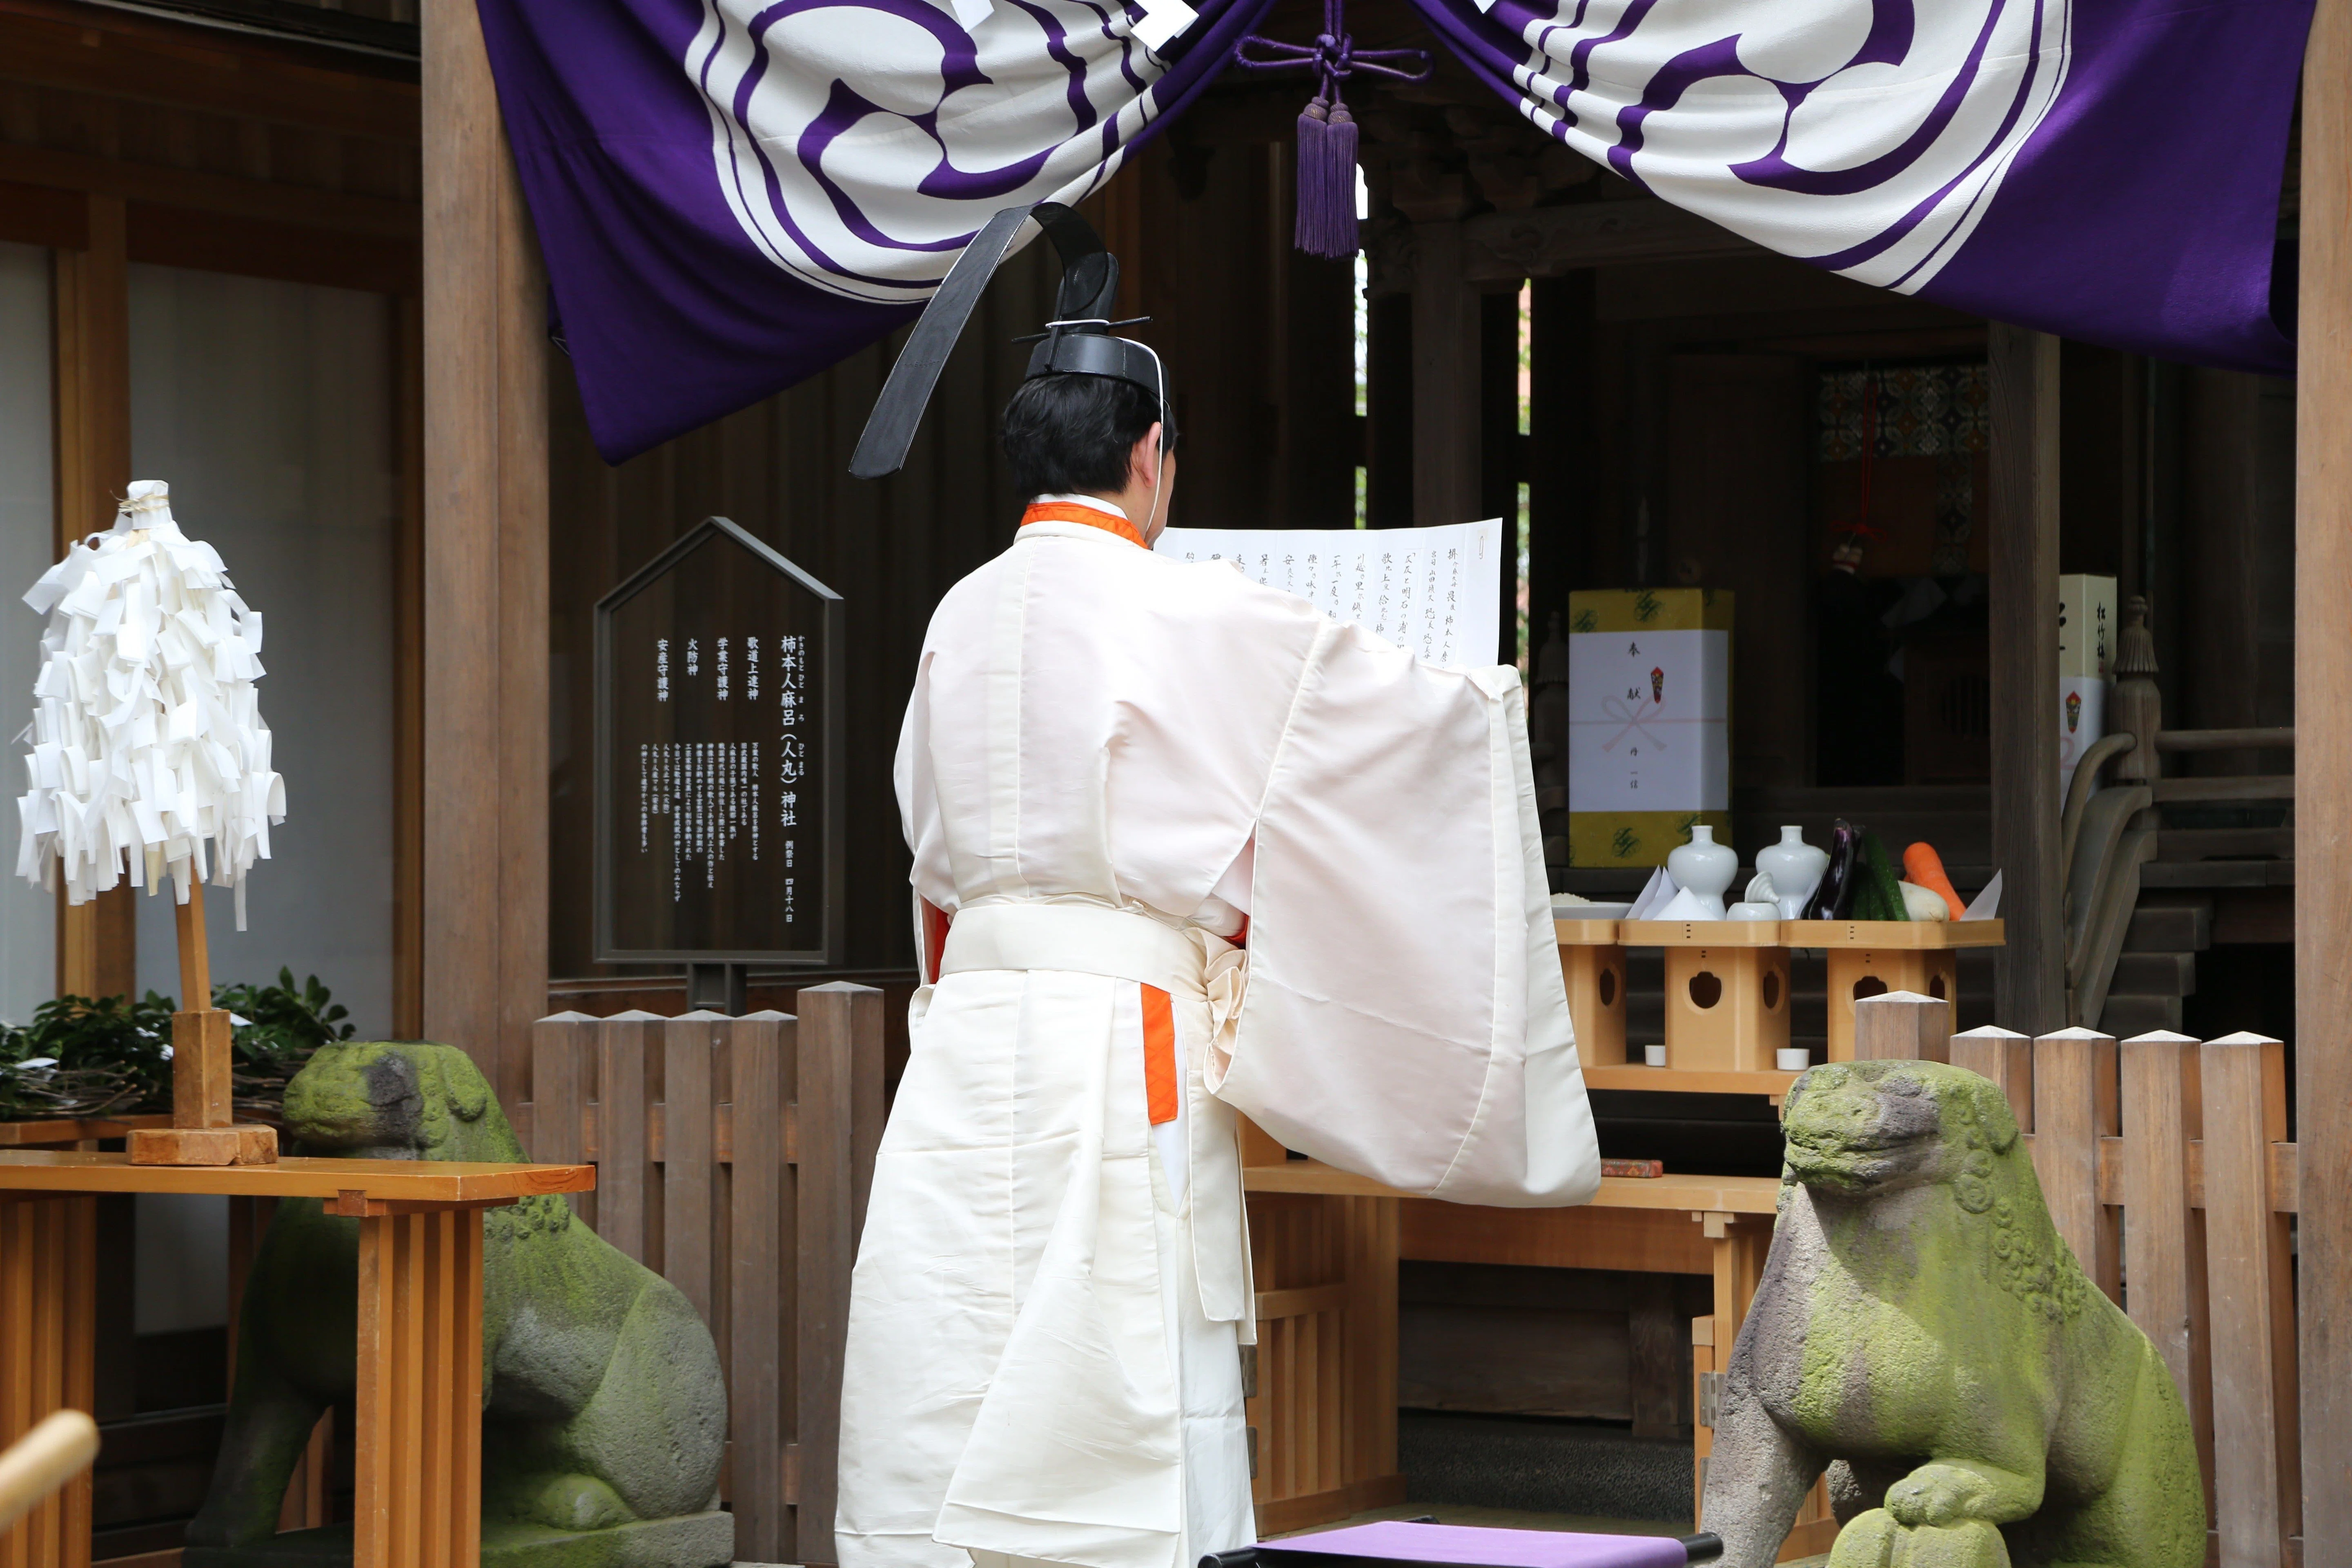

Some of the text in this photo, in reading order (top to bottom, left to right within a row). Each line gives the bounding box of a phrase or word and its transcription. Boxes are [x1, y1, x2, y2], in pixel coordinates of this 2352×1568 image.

[2097, 601, 2105, 660] 松竹梅
[657, 638, 669, 702] 安産守護神
[687, 638, 699, 676] 火防神
[717, 637, 729, 701] 学業守護神
[747, 636, 759, 700] 歌道上達神
[798, 674, 805, 688] ひと
[798, 714, 804, 722] ろ
[798, 743, 805, 757] ひと
[798, 761, 804, 776] まる
[785, 840, 794, 868] 例祭日
[785, 878, 794, 922] 四月十八日
